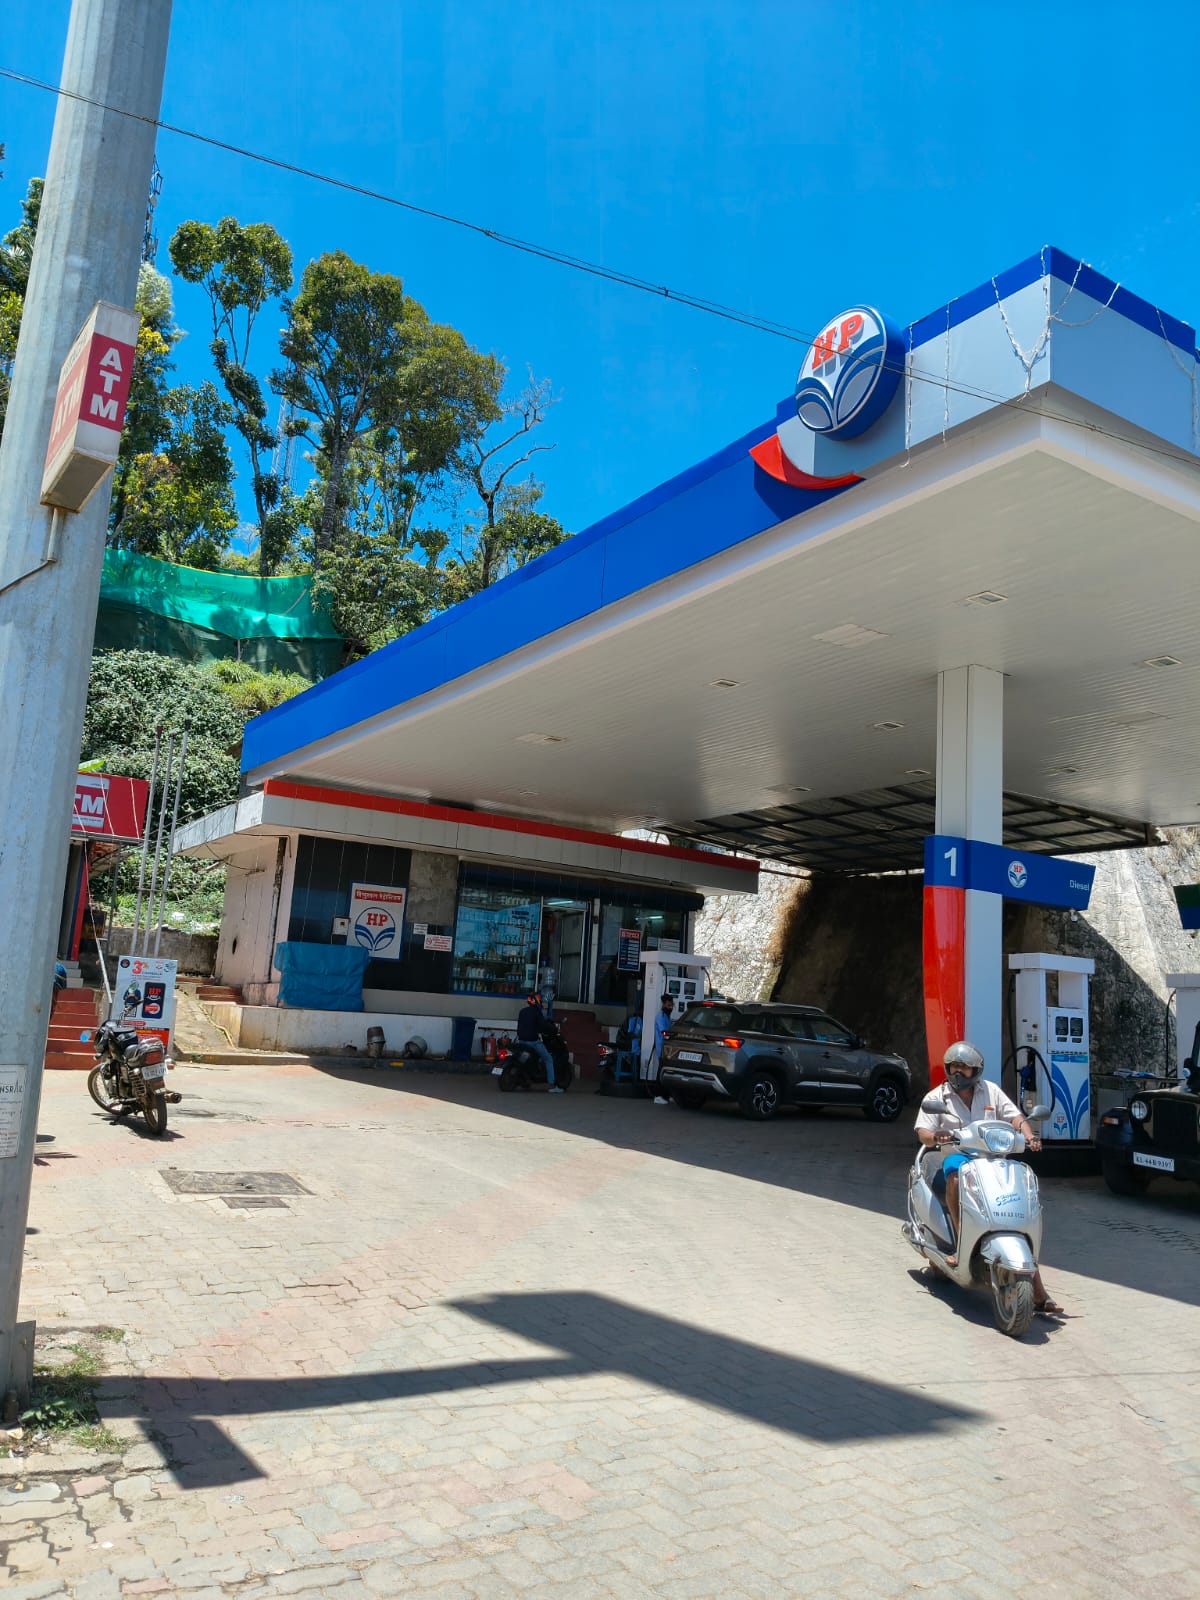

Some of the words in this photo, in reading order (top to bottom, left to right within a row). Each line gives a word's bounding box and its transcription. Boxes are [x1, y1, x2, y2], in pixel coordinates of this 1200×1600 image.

[811, 314, 864, 370] HP
[52, 365, 84, 443] ATM
[90, 347, 122, 421] ATM
[944, 847, 957, 877] 1
[1069, 879, 1090, 892] Diesel
[366, 912, 388, 927] HP
